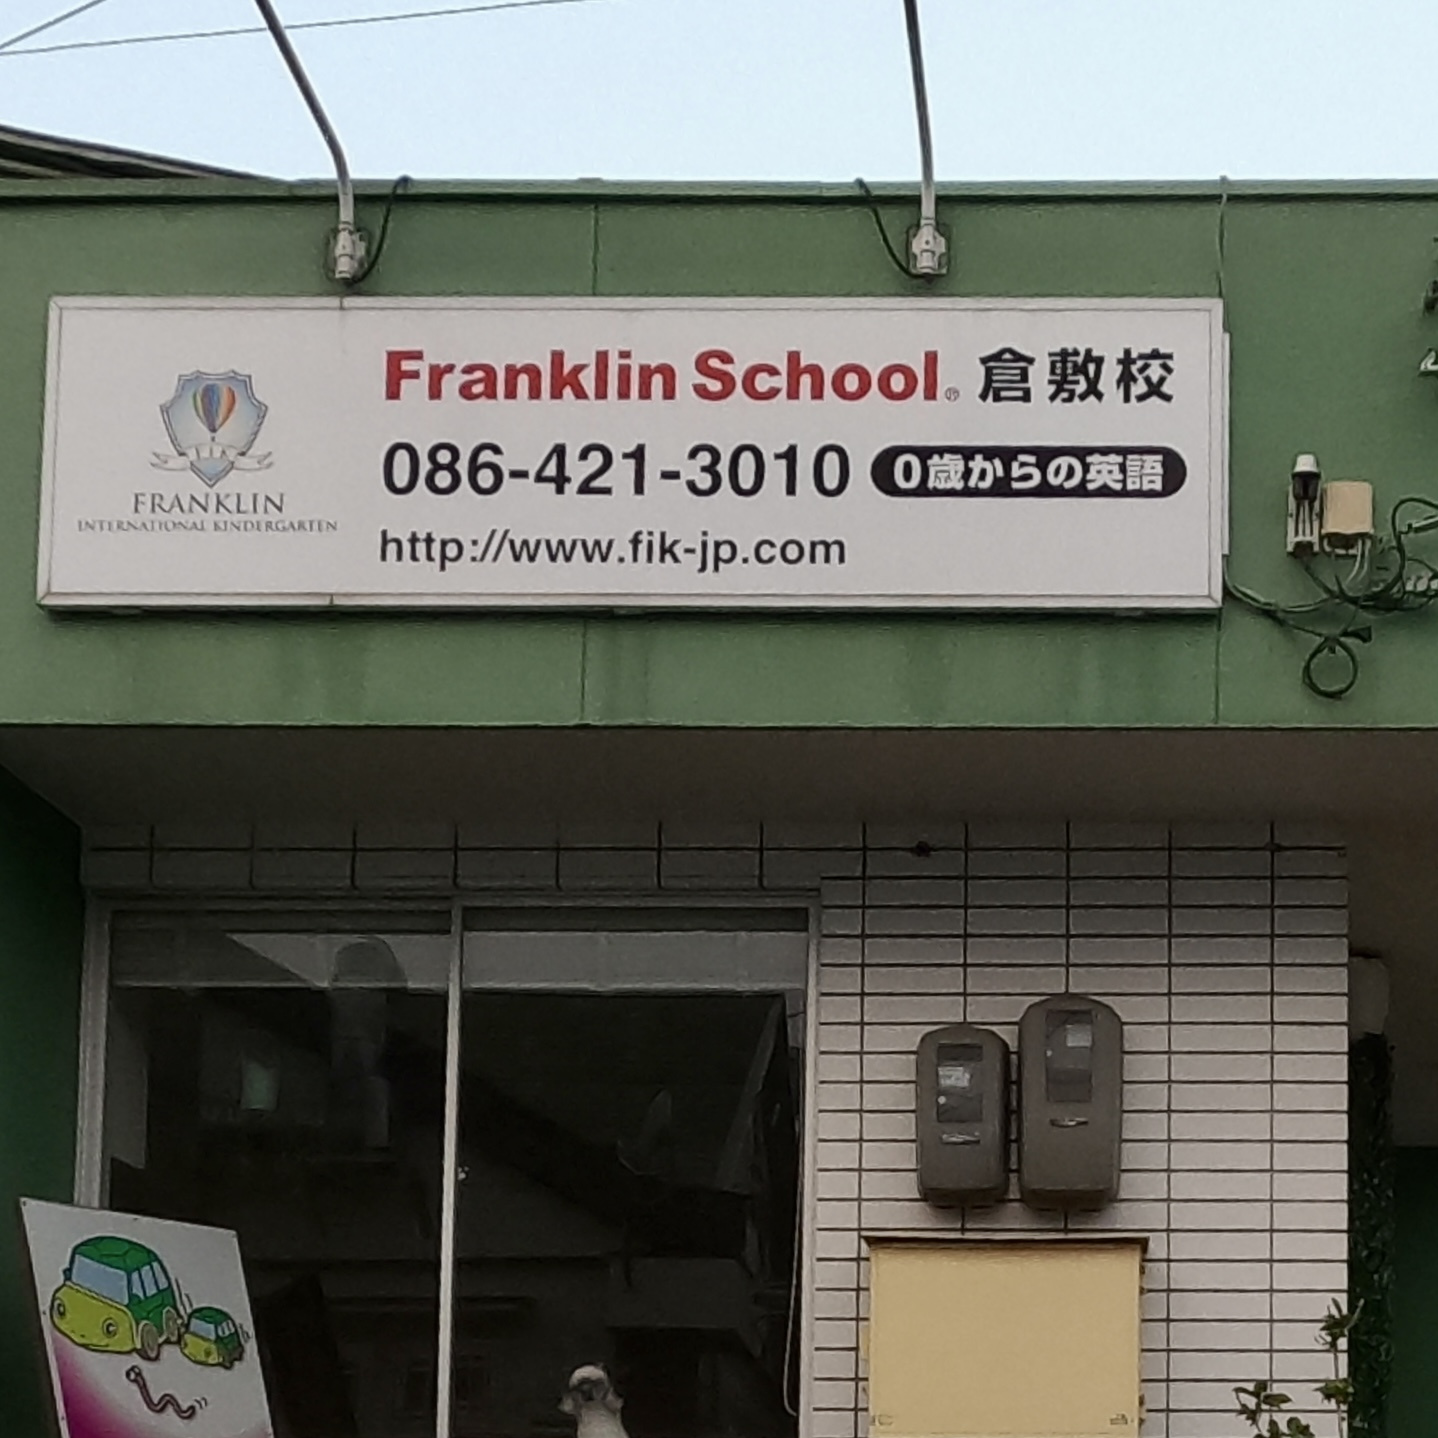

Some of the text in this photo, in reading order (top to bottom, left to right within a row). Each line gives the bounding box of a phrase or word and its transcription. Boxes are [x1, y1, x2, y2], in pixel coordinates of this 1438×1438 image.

[384, 346, 1175, 404] Franklin School 倉敷校
[382, 442, 851, 498] 086-421-3010
[893, 453, 1164, 492] 0歳からの英語
[132, 492, 285, 514] FRANKLIN
[77, 519, 339, 533] INTERNATIONAL KINDERGARTEN
[379, 528, 847, 573] http://www.fik-jp.com
